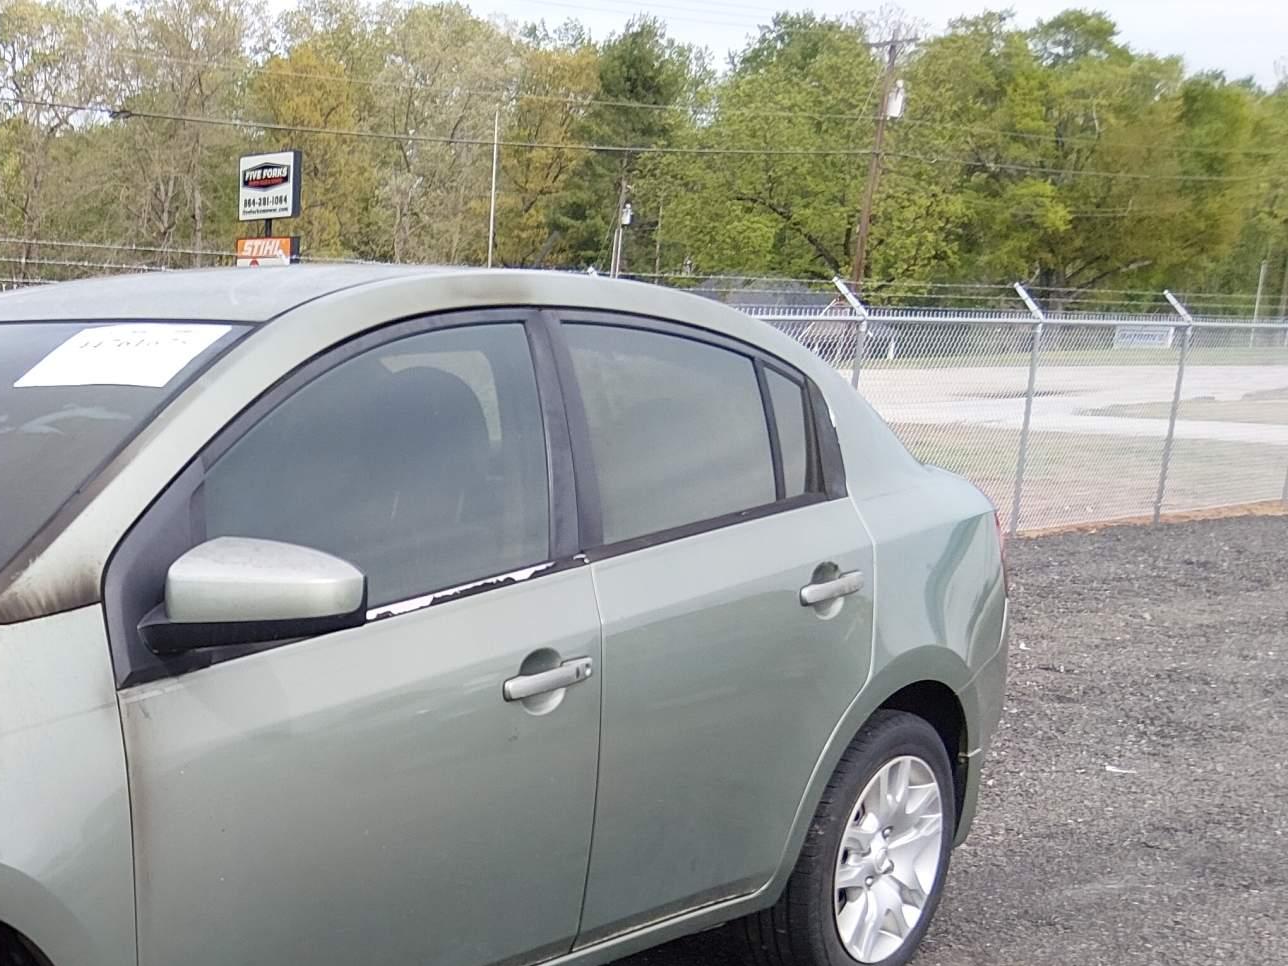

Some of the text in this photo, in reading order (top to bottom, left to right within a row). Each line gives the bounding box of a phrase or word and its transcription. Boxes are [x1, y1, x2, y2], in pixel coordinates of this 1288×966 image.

[245, 166, 288, 181] FIVE FORKS
[244, 239, 281, 257] STIHL
